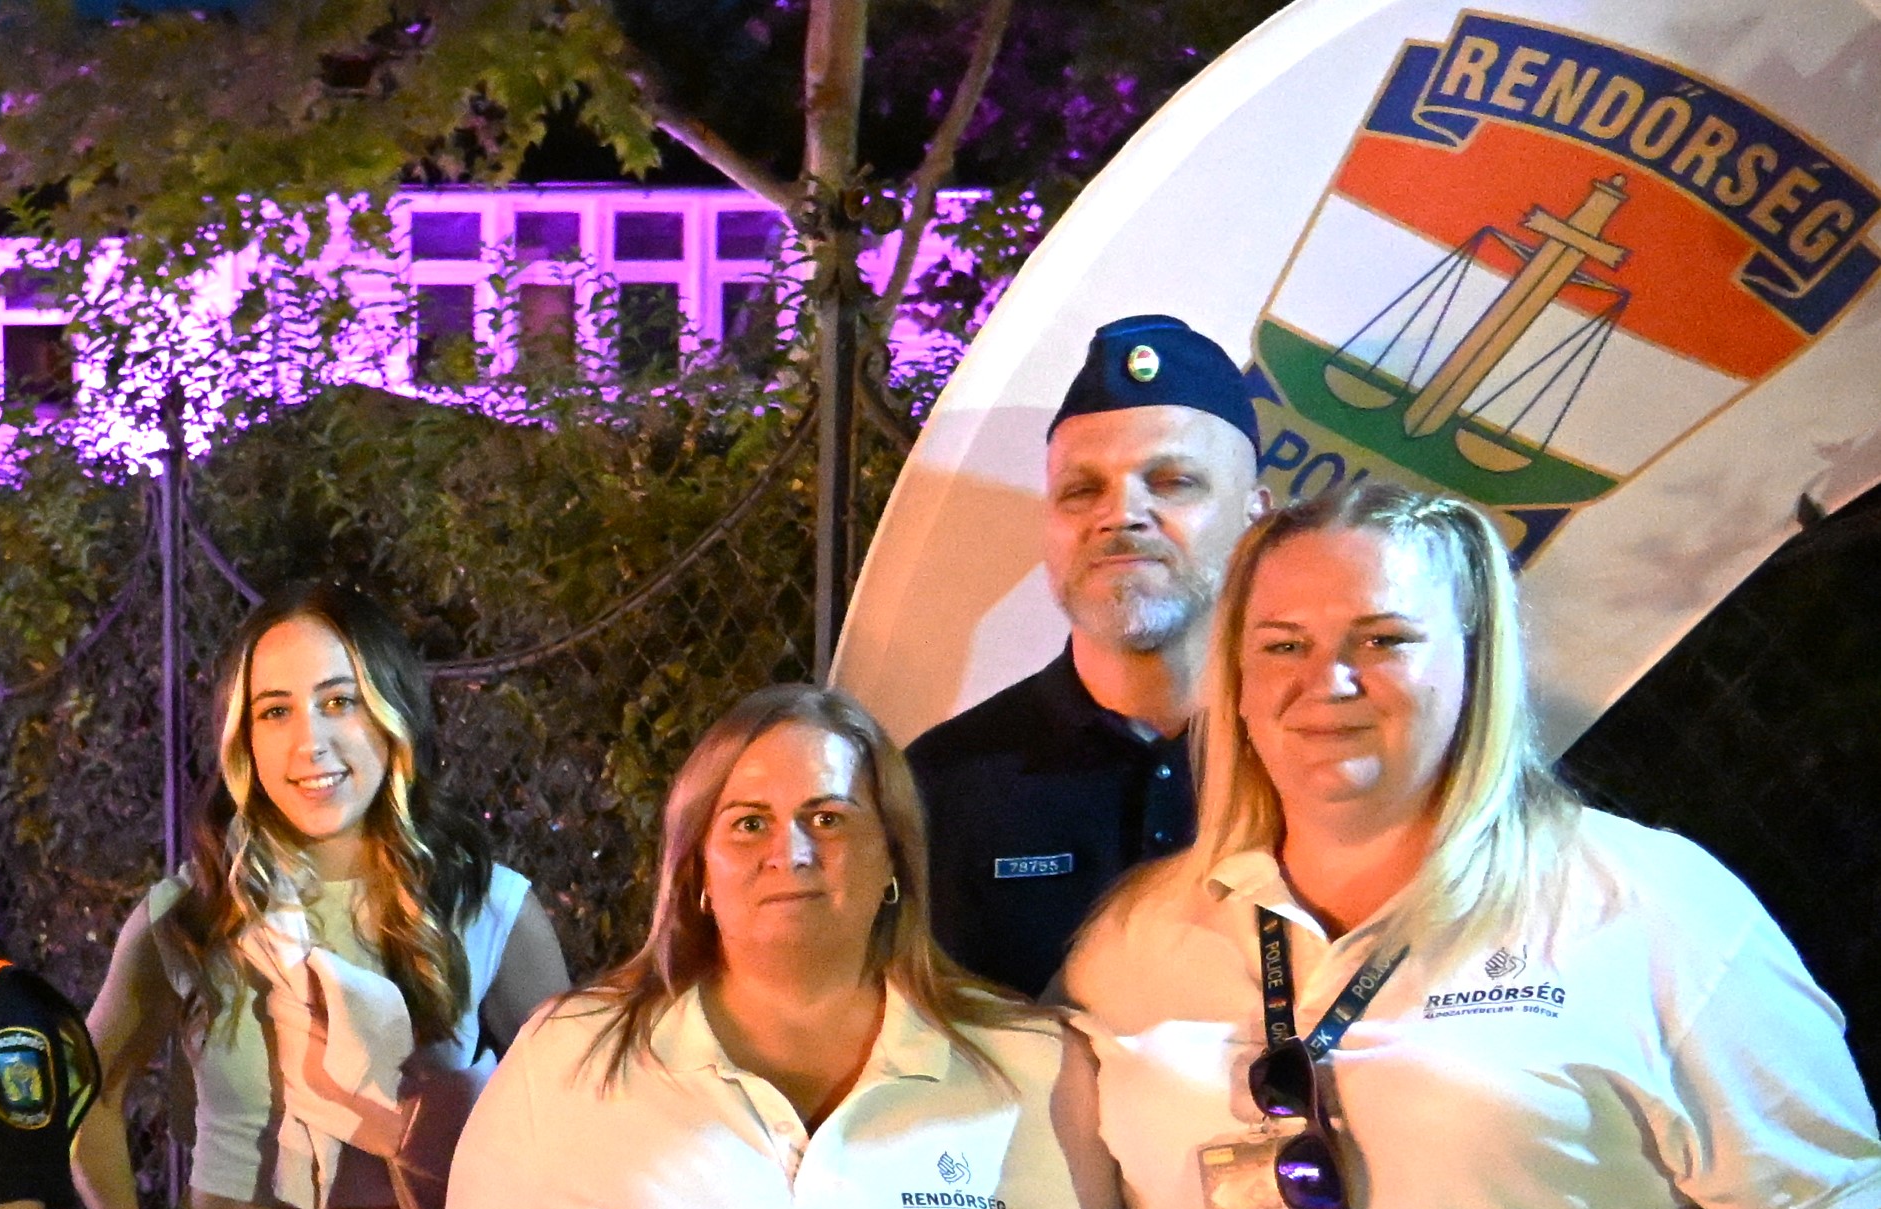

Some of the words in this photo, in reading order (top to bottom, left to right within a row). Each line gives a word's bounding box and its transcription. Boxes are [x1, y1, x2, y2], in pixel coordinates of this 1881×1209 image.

[1440, 35, 1855, 264] RENDŐRSÉG
[1265, 940, 1284, 989] POLICE
[1425, 982, 1566, 1008] RENDŐRSÉG
[1522, 1005, 1559, 1018] SIÓFOK
